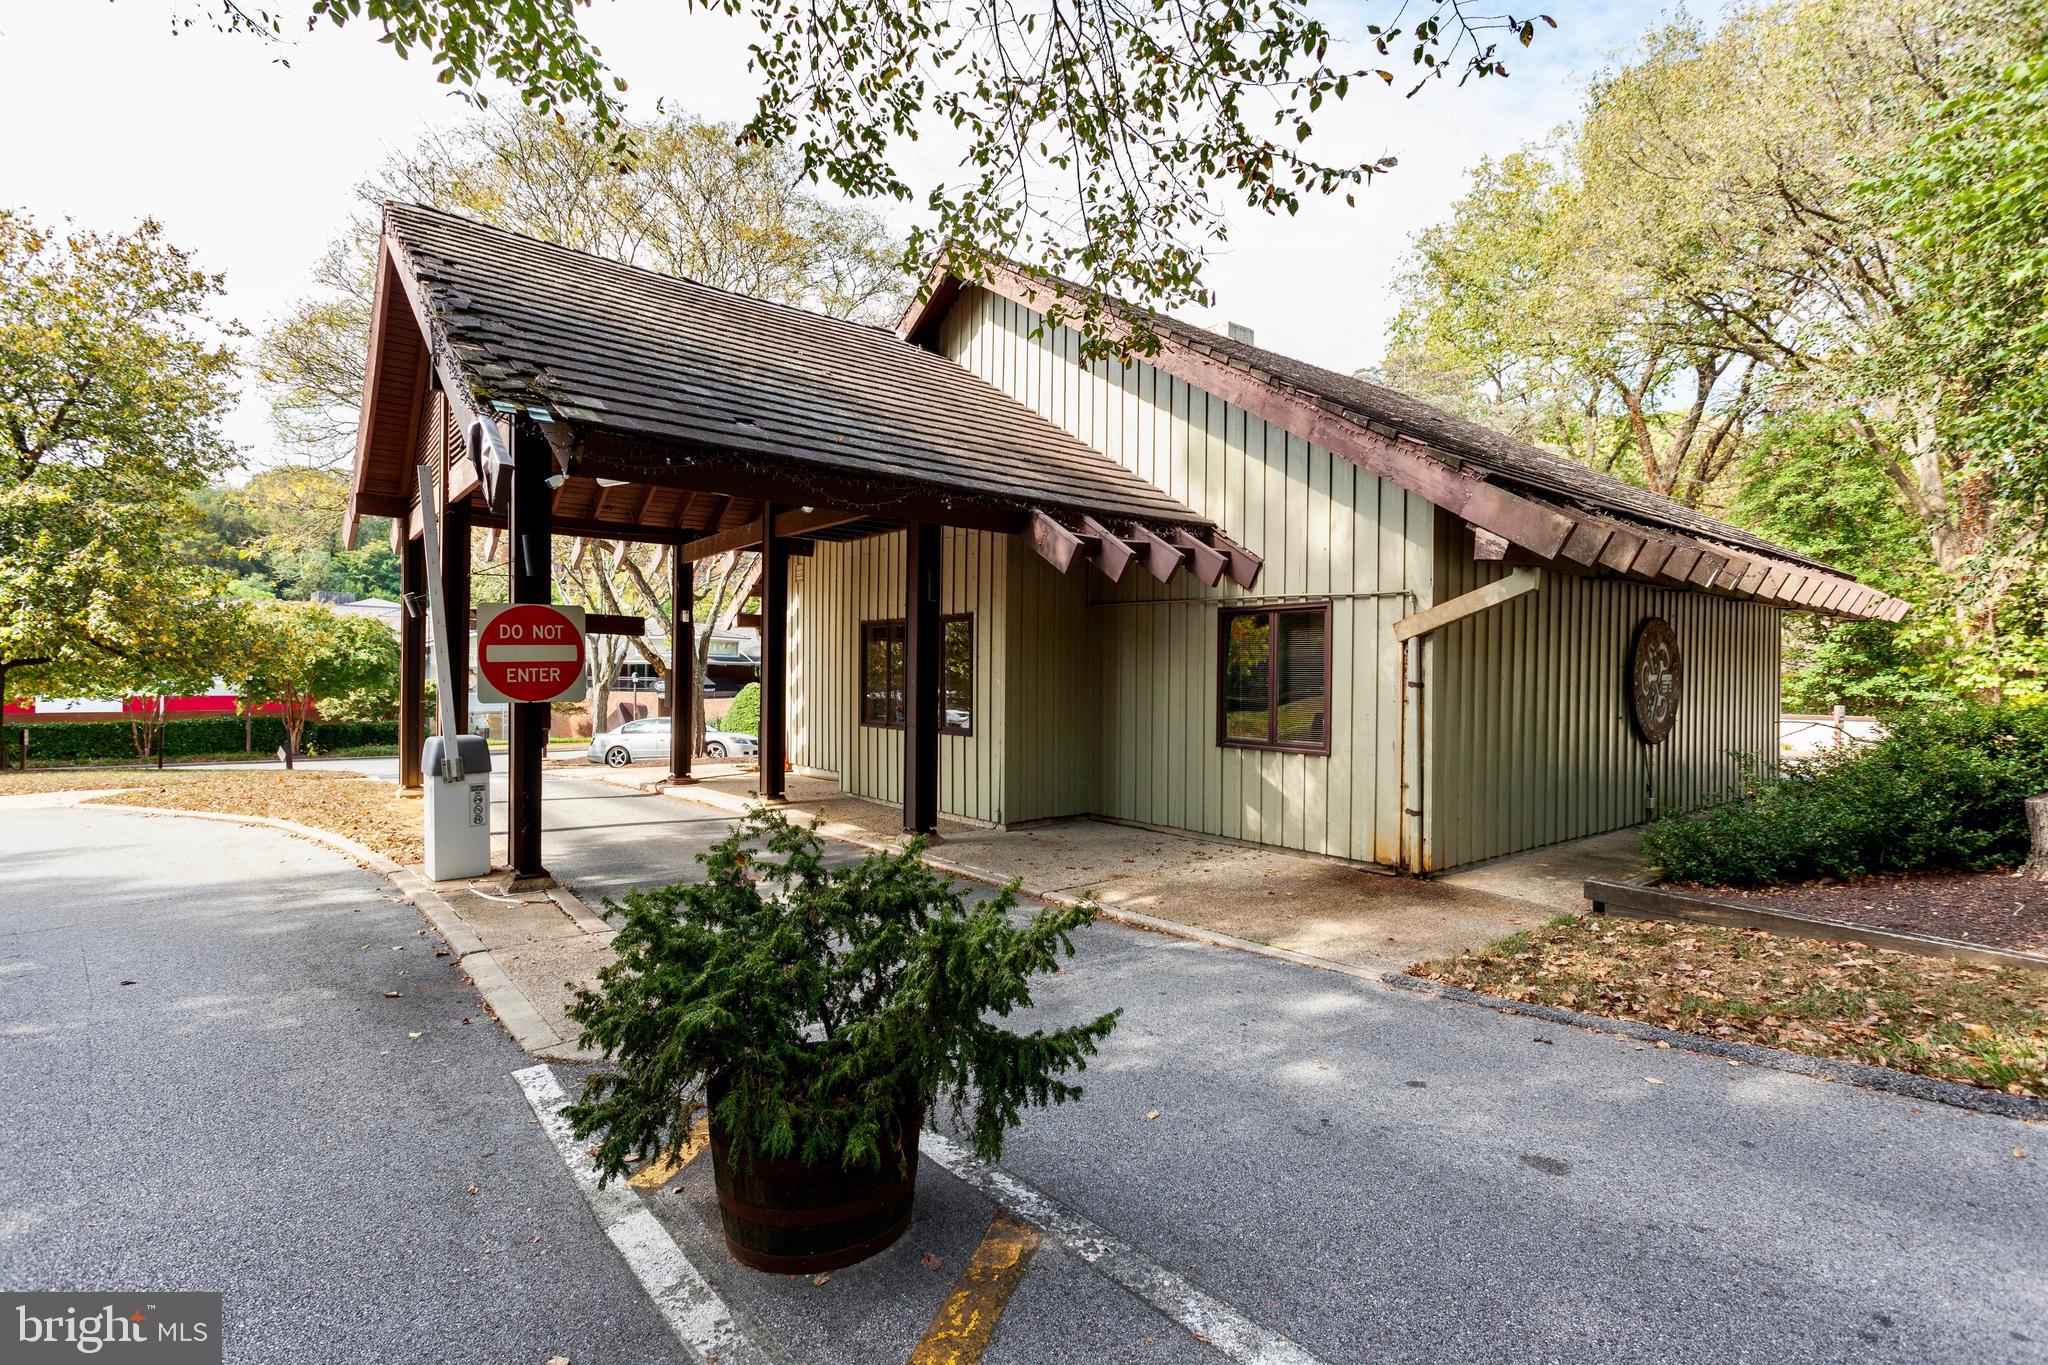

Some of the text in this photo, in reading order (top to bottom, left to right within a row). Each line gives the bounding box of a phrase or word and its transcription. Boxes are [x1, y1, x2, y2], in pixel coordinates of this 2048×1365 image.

[499, 624, 564, 639] DO NOT
[506, 667, 561, 683] ENTER
